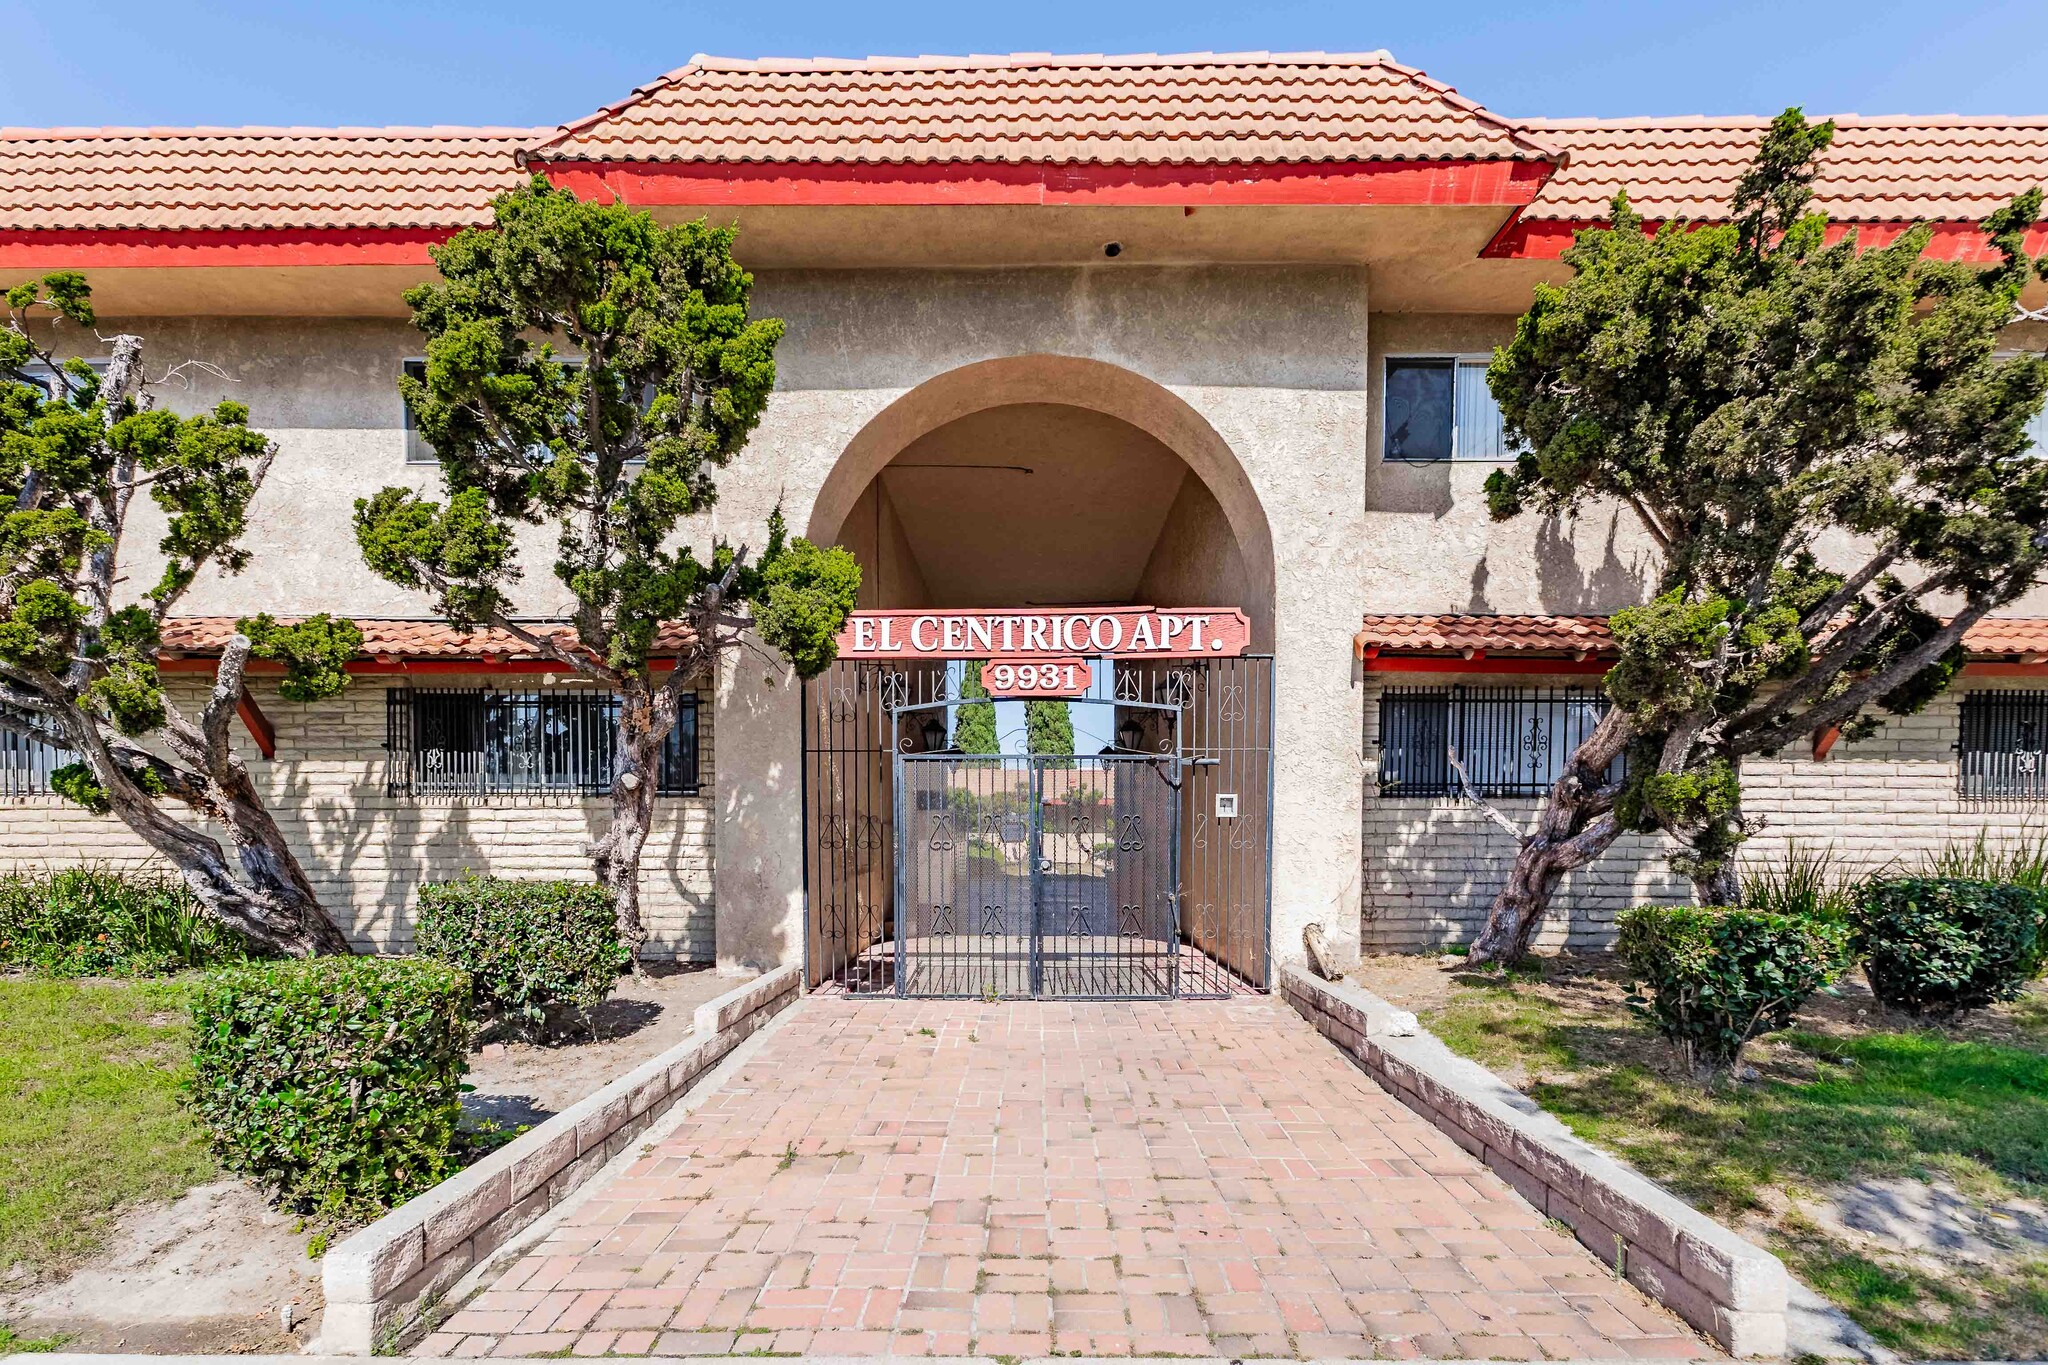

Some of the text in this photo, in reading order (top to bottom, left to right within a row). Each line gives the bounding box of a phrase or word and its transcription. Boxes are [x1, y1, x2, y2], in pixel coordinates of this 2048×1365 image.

[852, 614, 1223, 652] EL CENTRICO APT.
[994, 664, 1079, 691] 9931
